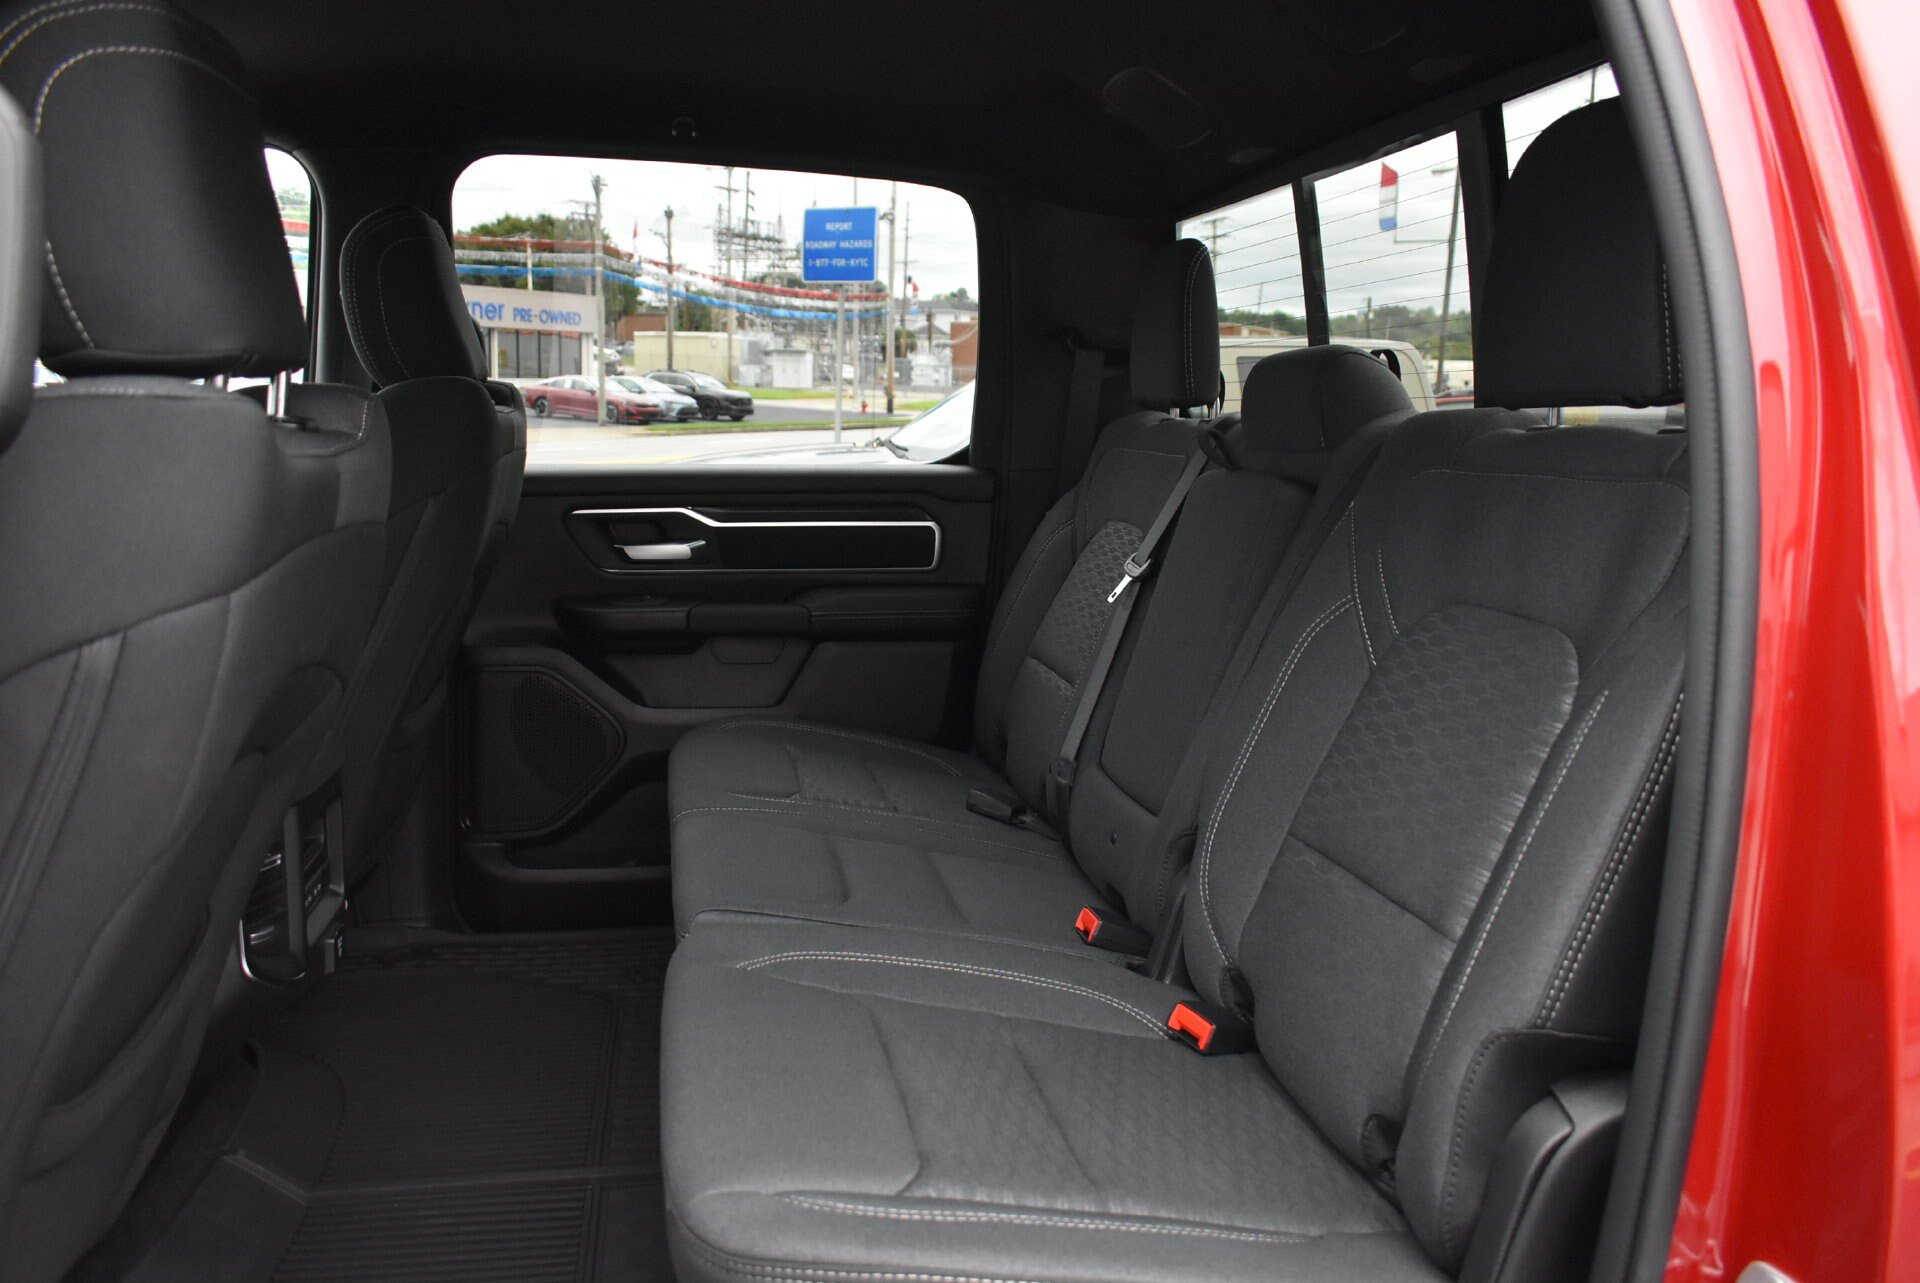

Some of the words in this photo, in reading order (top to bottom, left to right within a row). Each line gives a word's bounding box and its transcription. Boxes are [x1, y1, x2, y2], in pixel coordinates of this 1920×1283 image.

[825, 222, 853, 231] REPORT
[805, 240, 837, 249] ROADWAY
[839, 239, 873, 248] HAZARDS
[467, 301, 505, 321] ner
[513, 306, 581, 326] PRE-OWNED
